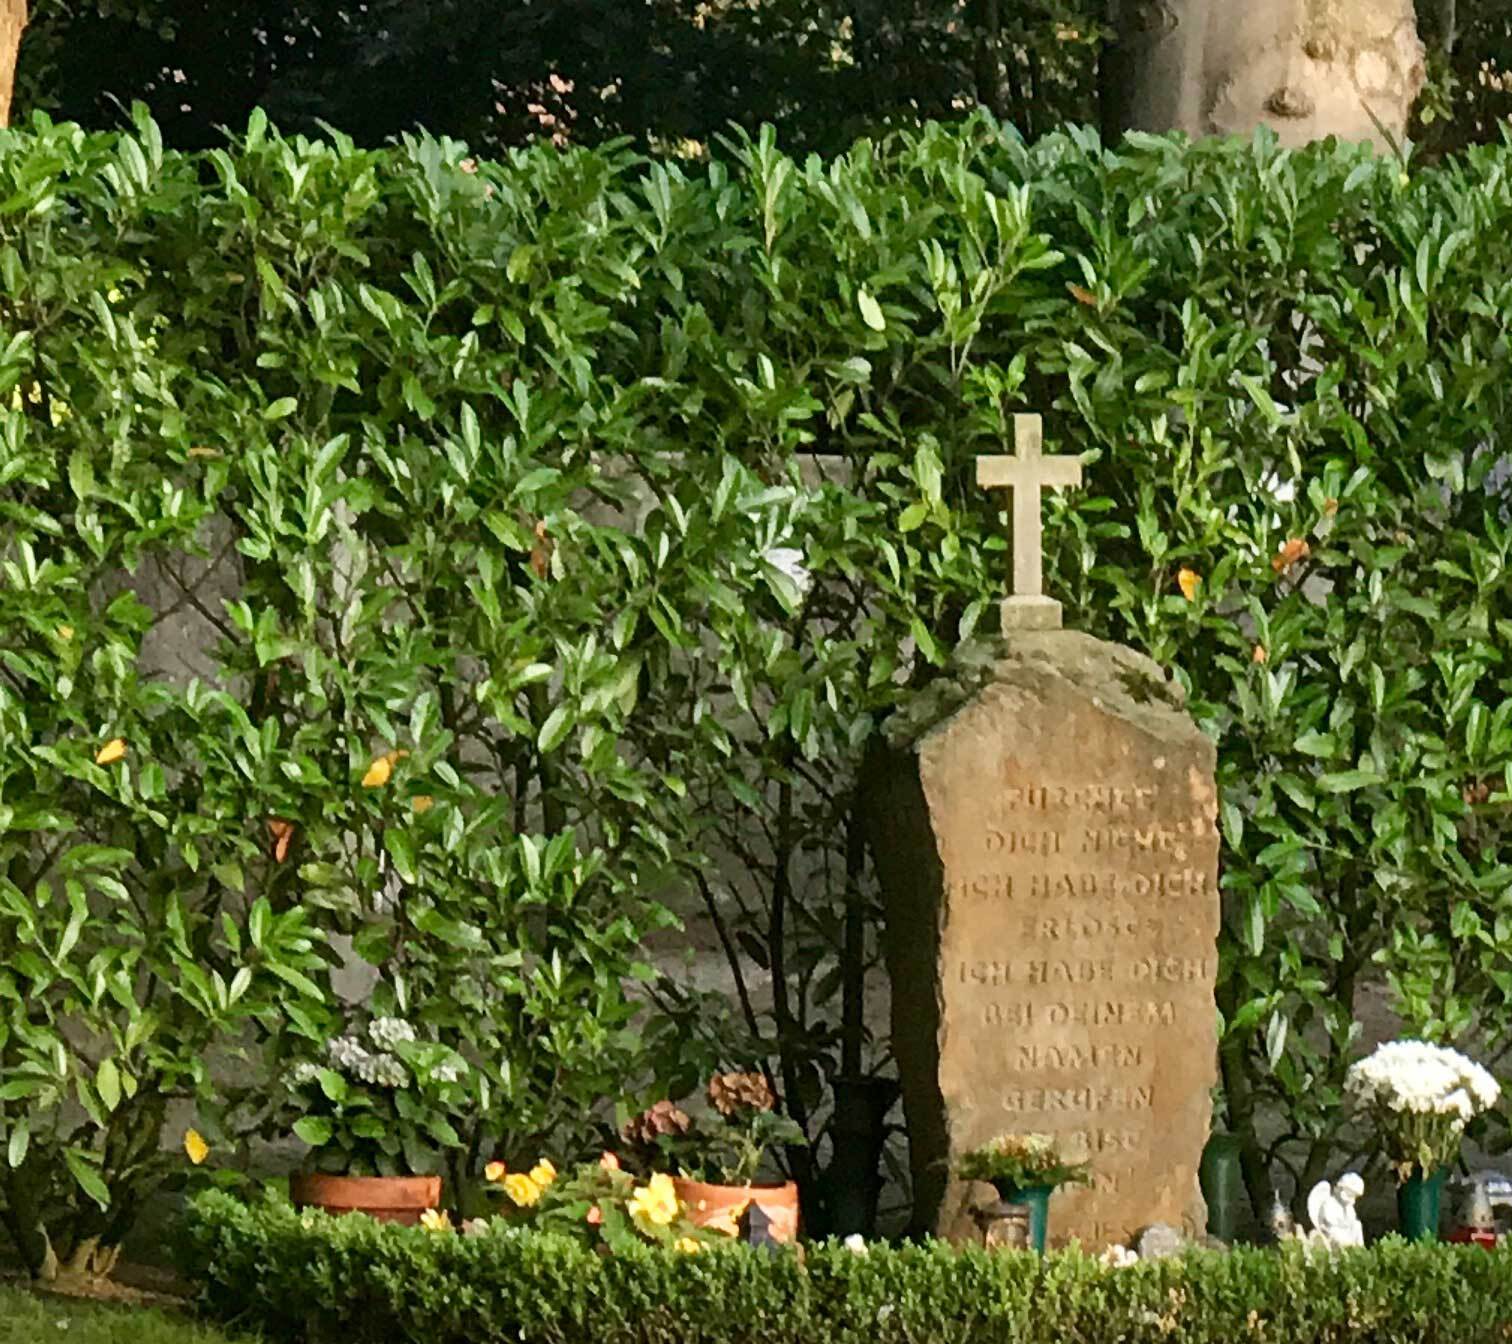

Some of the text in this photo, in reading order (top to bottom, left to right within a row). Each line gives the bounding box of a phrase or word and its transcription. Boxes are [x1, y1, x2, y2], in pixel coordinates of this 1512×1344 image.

[985, 828, 1175, 857] DICH NICHT
[961, 867, 1209, 900] ICH HABE DICH
[959, 957, 1208, 986] ICH HABE DICH
[983, 1000, 1177, 1027] BEI DEINEM
[1015, 1044, 1143, 1070] NAMEN
[1002, 1085, 1155, 1111] GERUFEN
